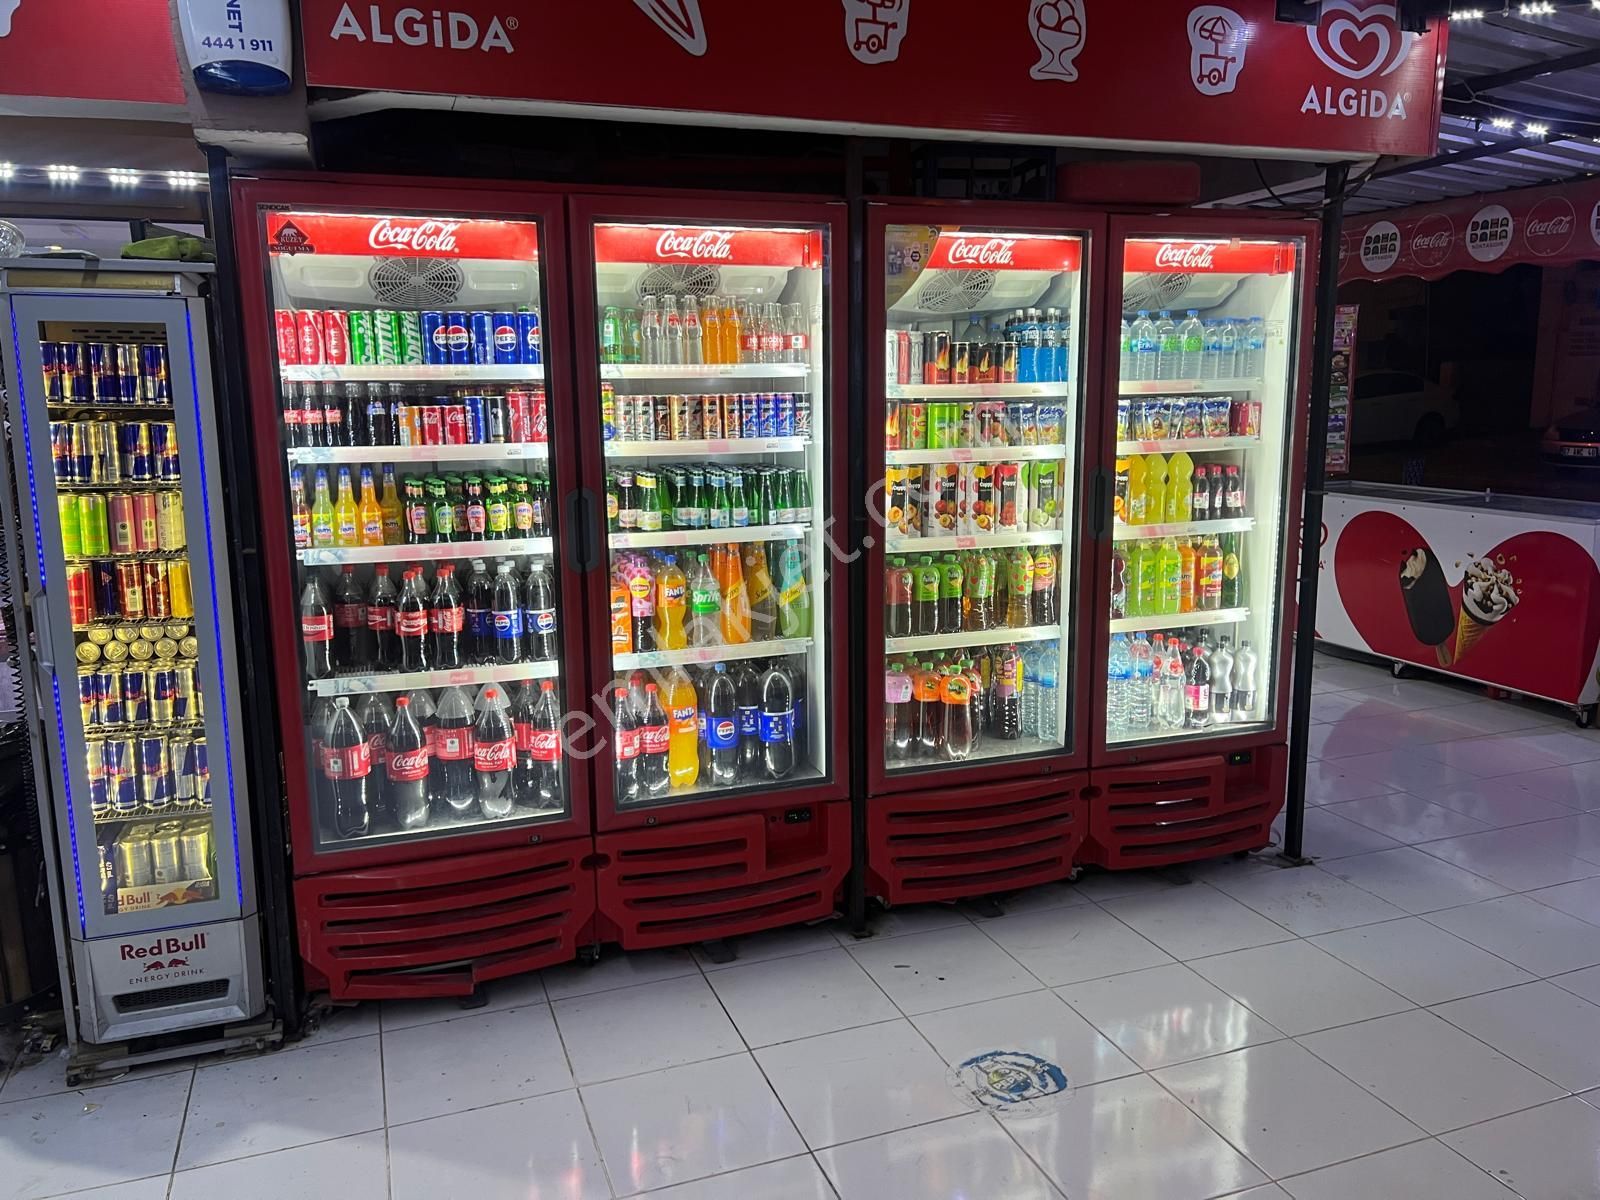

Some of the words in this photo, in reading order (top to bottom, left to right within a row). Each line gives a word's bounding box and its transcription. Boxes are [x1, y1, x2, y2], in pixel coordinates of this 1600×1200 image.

[330, 2, 514, 54] ALGiDA
[201, 36, 234, 49] 444
[238, 38, 245, 50] 1
[250, 39, 273, 52] 911
[1300, 85, 1407, 120] ALGiDA
[1471, 217, 1509, 232] DAHA
[368, 219, 460, 252] Coca-Cola
[655, 230, 735, 259] Coca-Cola
[1365, 232, 1397, 246] DAHA
[1470, 229, 1508, 243] DAHA
[948, 239, 1017, 265] Coca-Cola
[1155, 243, 1216, 268] Coca-Cola
[1363, 243, 1396, 256] DAHA
[124, 892, 151, 906] Bull
[120, 938, 162, 960] Red
[166, 932, 206, 954] Bull
[129, 973, 170, 985] ENERGY
[174, 967, 205, 979] DRINK
